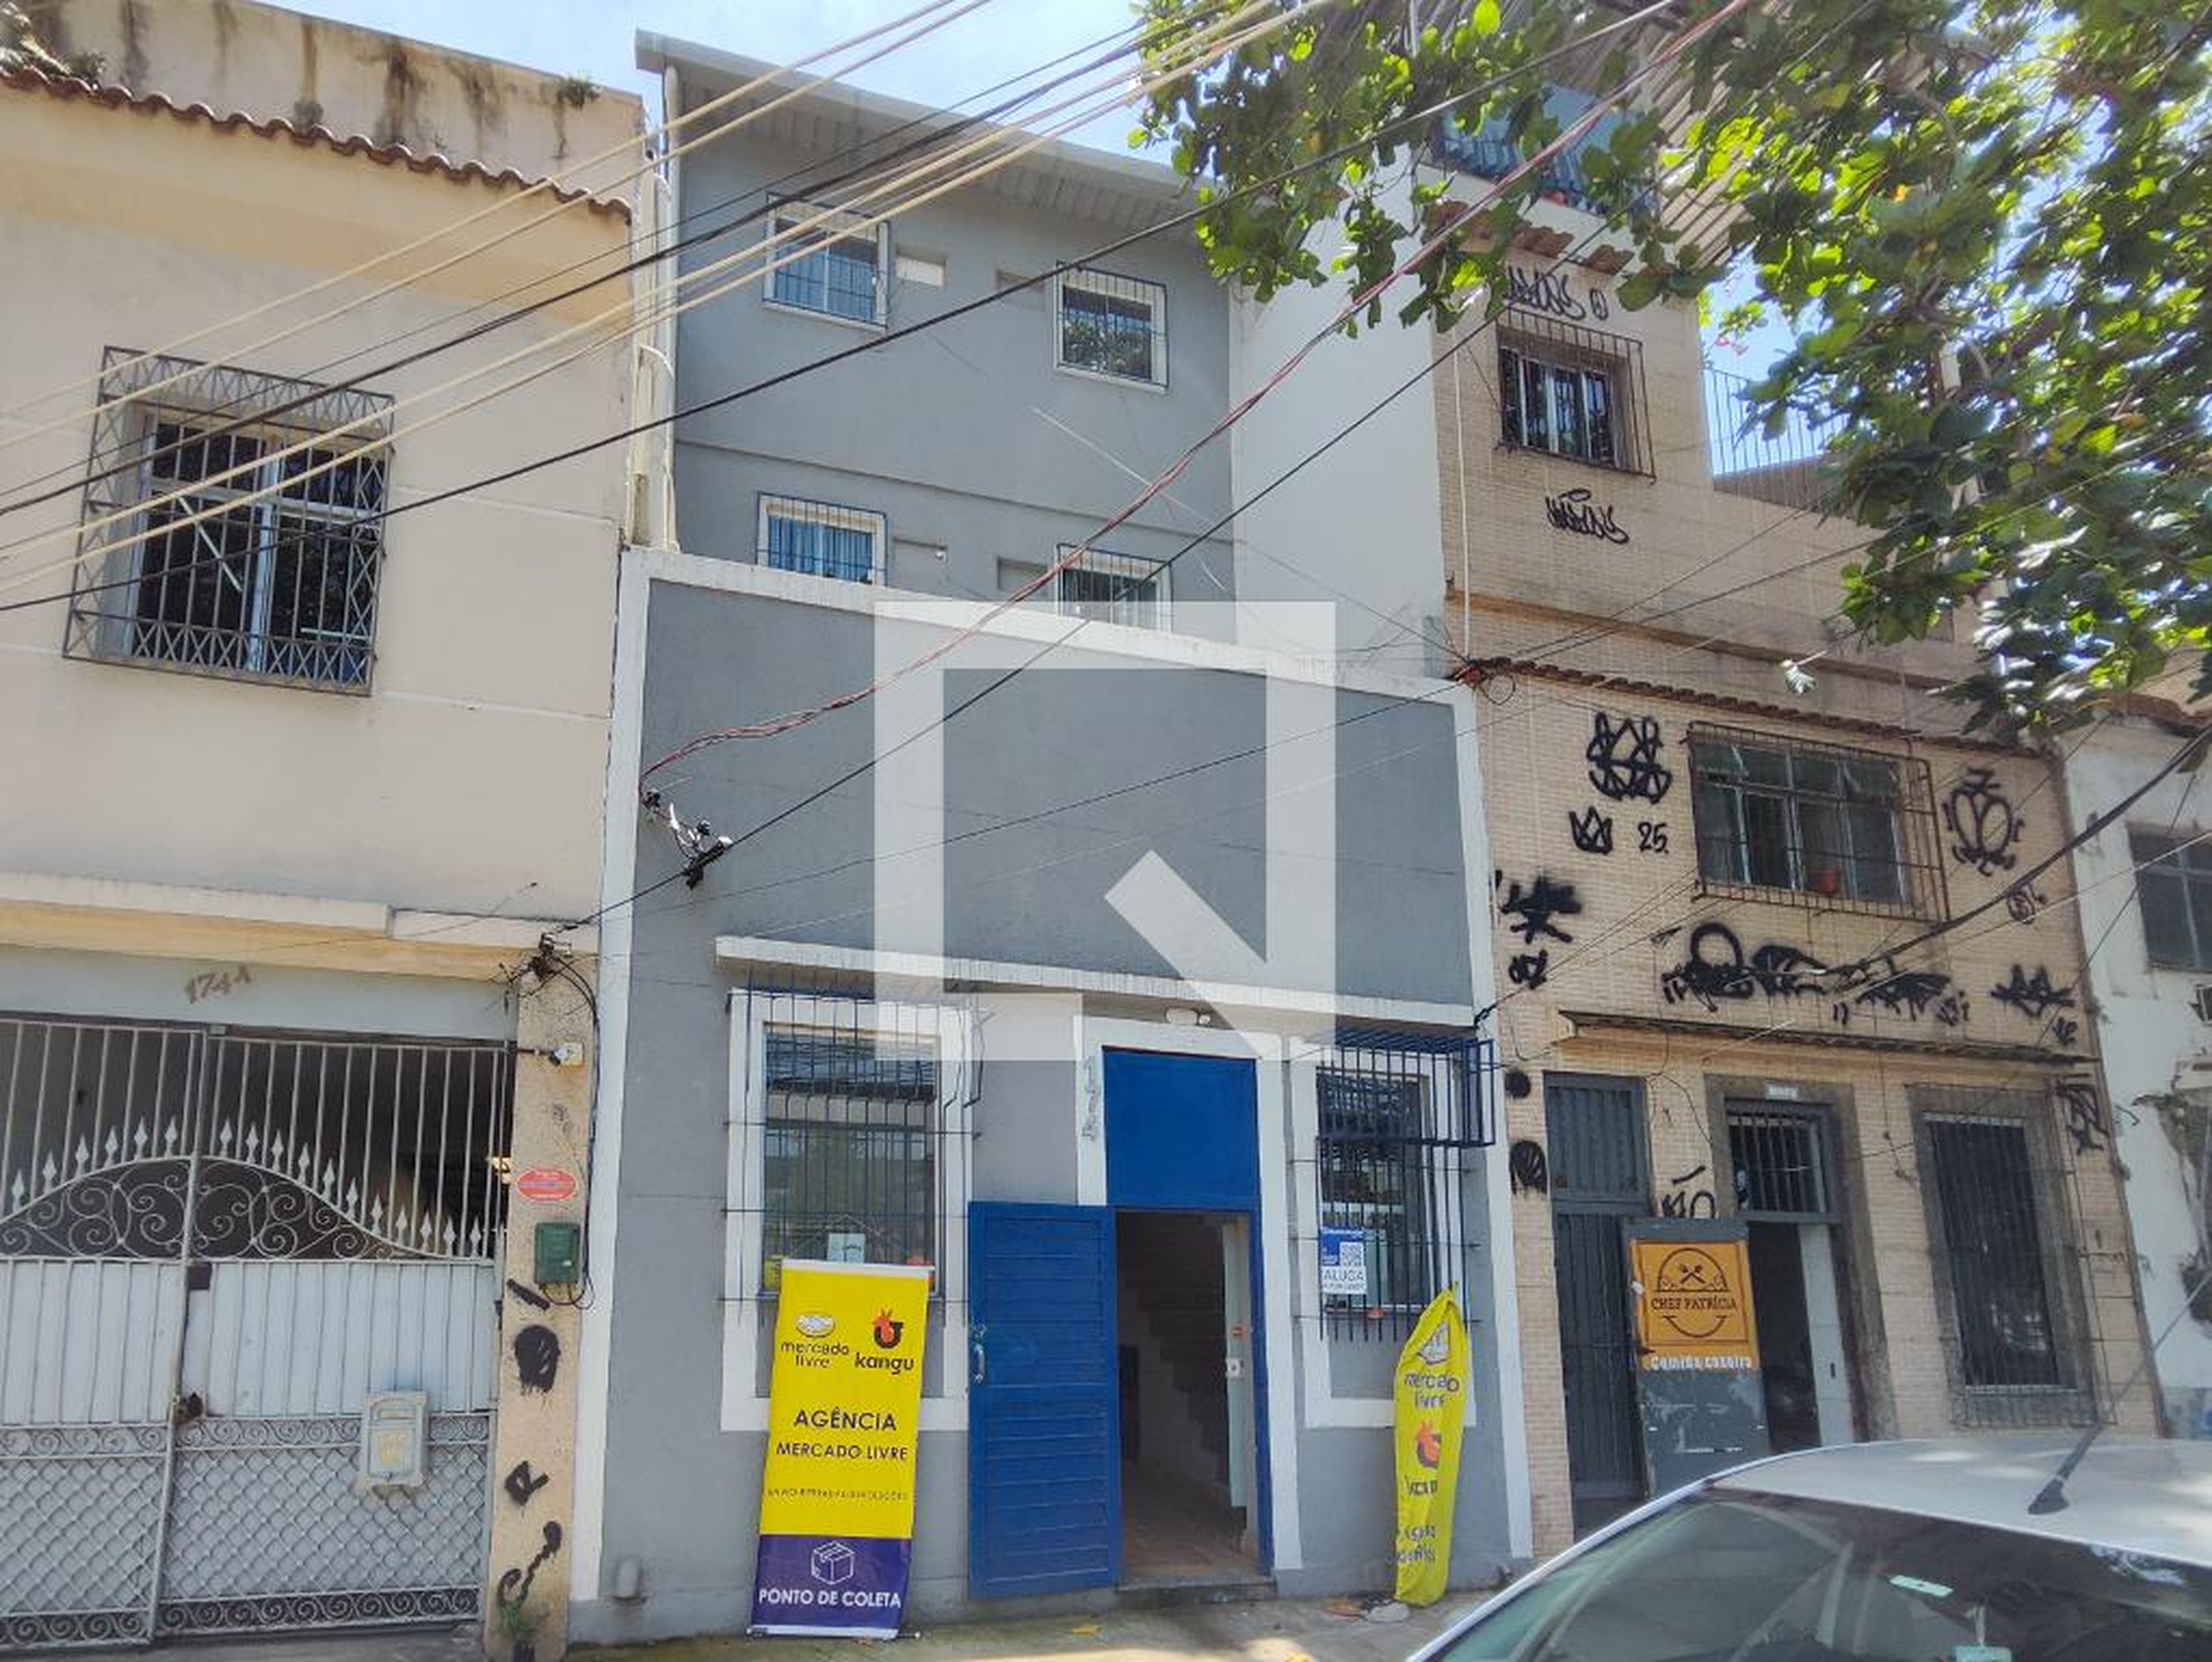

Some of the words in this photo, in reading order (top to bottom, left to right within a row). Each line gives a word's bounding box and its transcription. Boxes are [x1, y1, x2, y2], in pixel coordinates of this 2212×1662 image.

[1651, 1297, 1681, 1310] CHEF
[781, 1341, 849, 1356] mercado
[796, 1355, 830, 1368] livre
[854, 1352, 914, 1375] kangu
[793, 1406, 896, 1430] AGÊNCIA
[776, 1442, 861, 1459] MERCADO
[866, 1445, 908, 1460] LIVRE
[759, 1588, 813, 1604] PONTO
[818, 1591, 838, 1605] DE
[842, 1592, 901, 1608] COLETA
